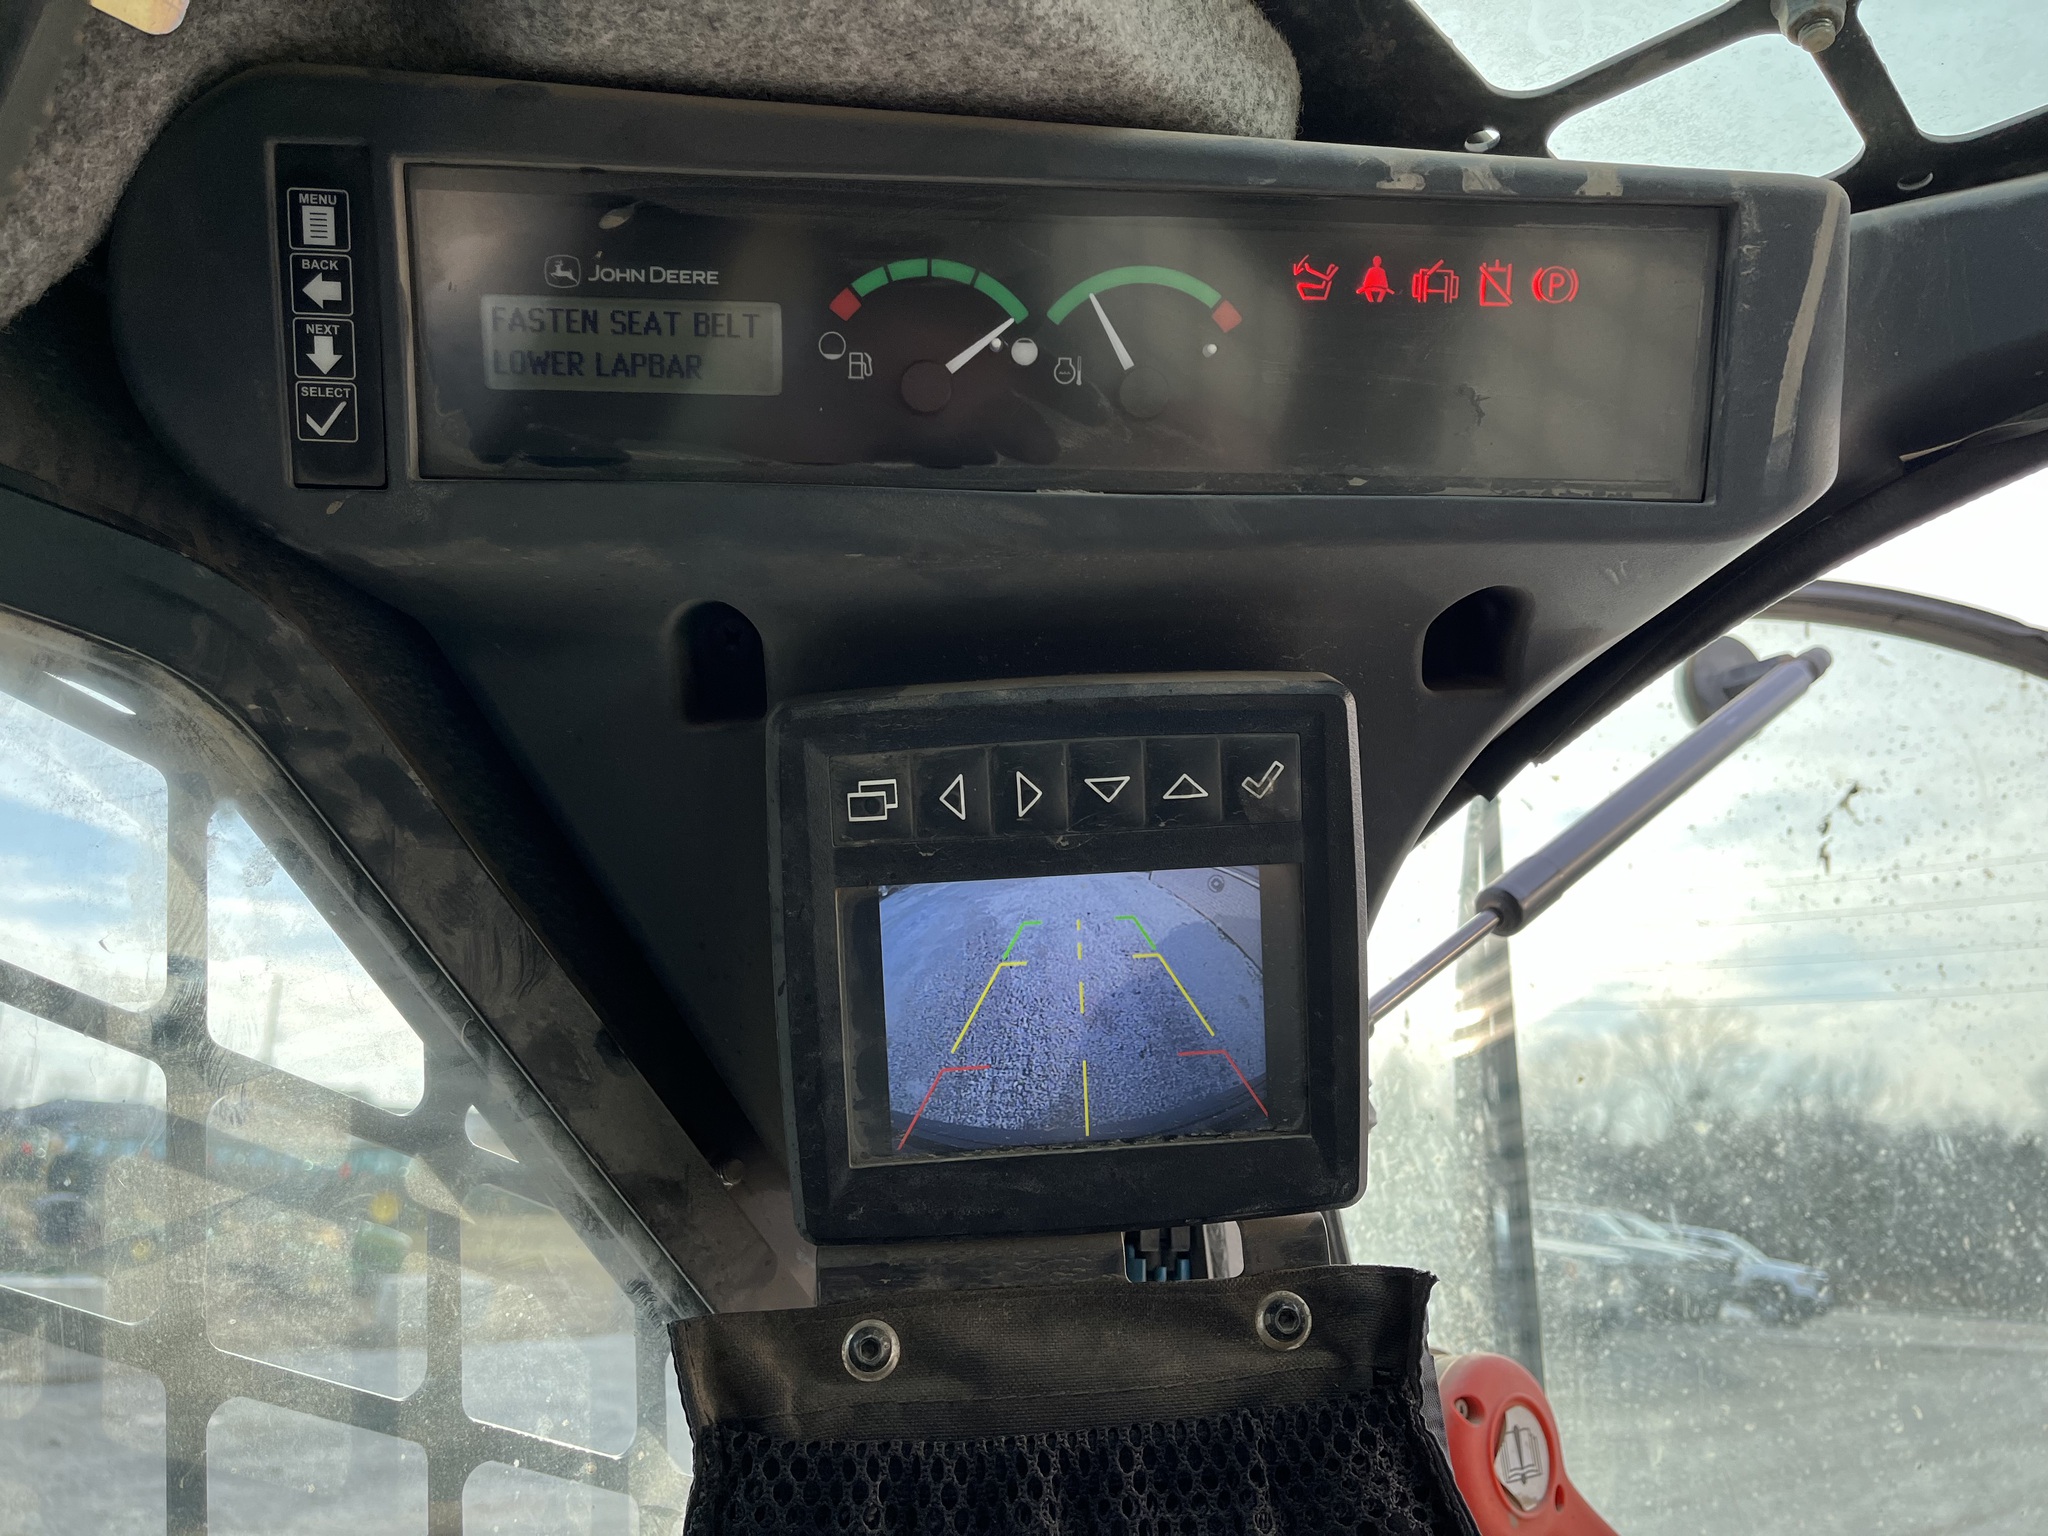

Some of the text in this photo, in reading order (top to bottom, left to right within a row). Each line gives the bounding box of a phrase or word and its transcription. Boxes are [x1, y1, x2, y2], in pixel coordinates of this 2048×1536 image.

[299, 193, 337, 205] MENU
[301, 259, 339, 271] BACK
[491, 306, 761, 339] FASTEN SEAT BELT
[305, 324, 340, 335] NEXT
[493, 349, 703, 380] LOWER LAPBAR
[301, 386, 351, 398] SELECT
